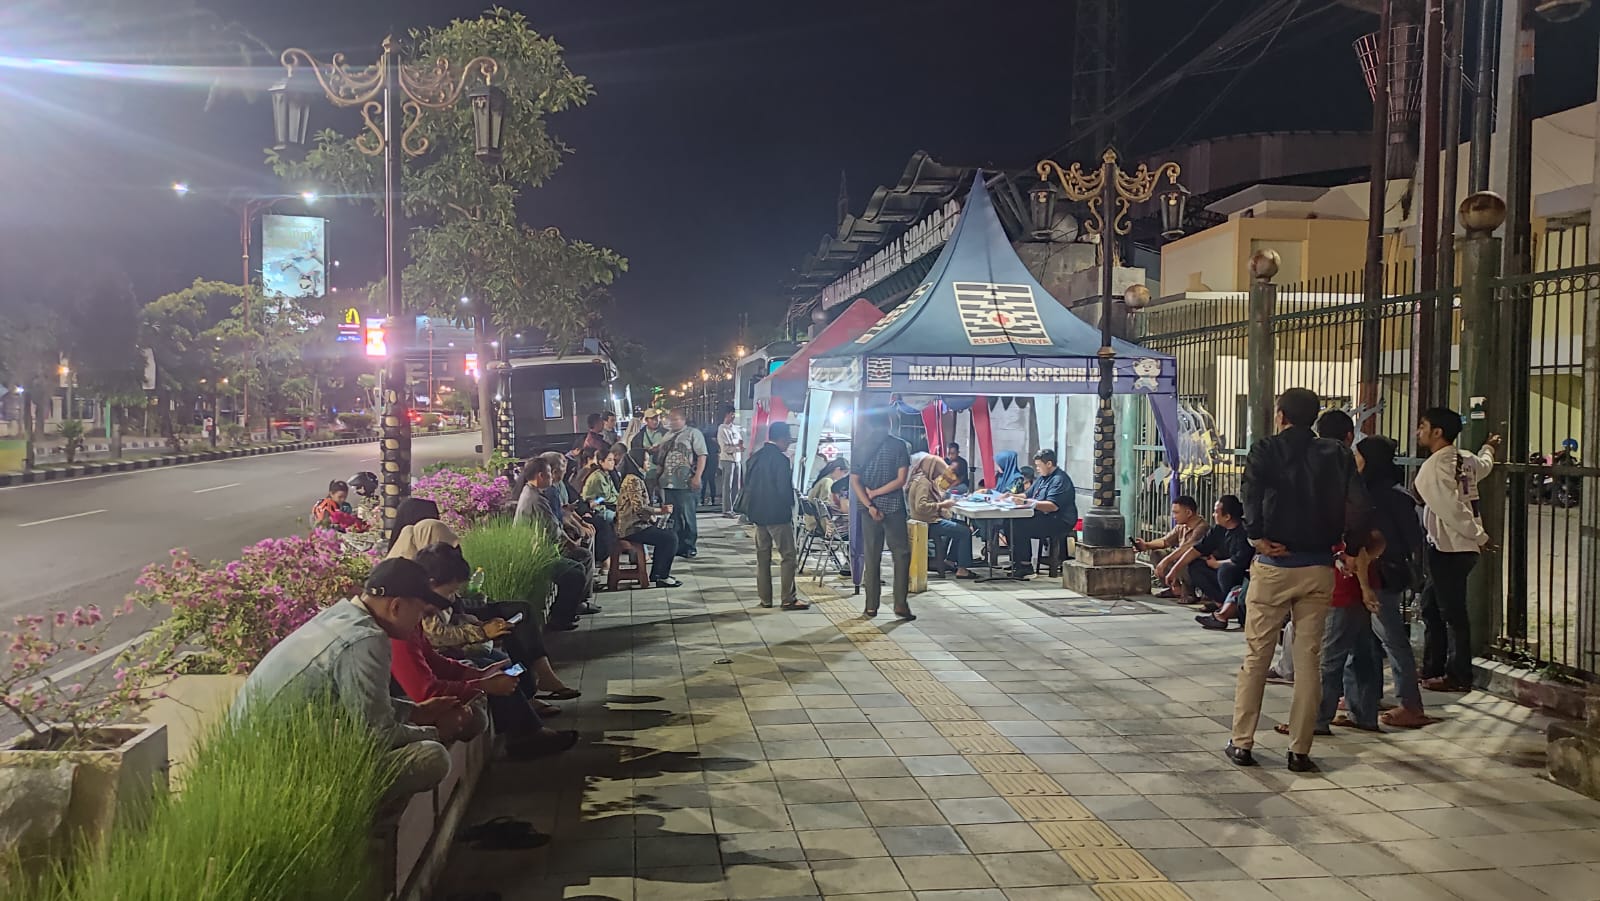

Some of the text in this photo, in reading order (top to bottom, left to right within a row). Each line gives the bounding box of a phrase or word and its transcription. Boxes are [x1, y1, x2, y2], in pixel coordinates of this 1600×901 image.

[903, 199, 960, 264] SIDOARJO
[1019, 337, 1050, 345] SURYA
[909, 365, 1118, 382] MELAYANI DENGAN SEPENUH HI
